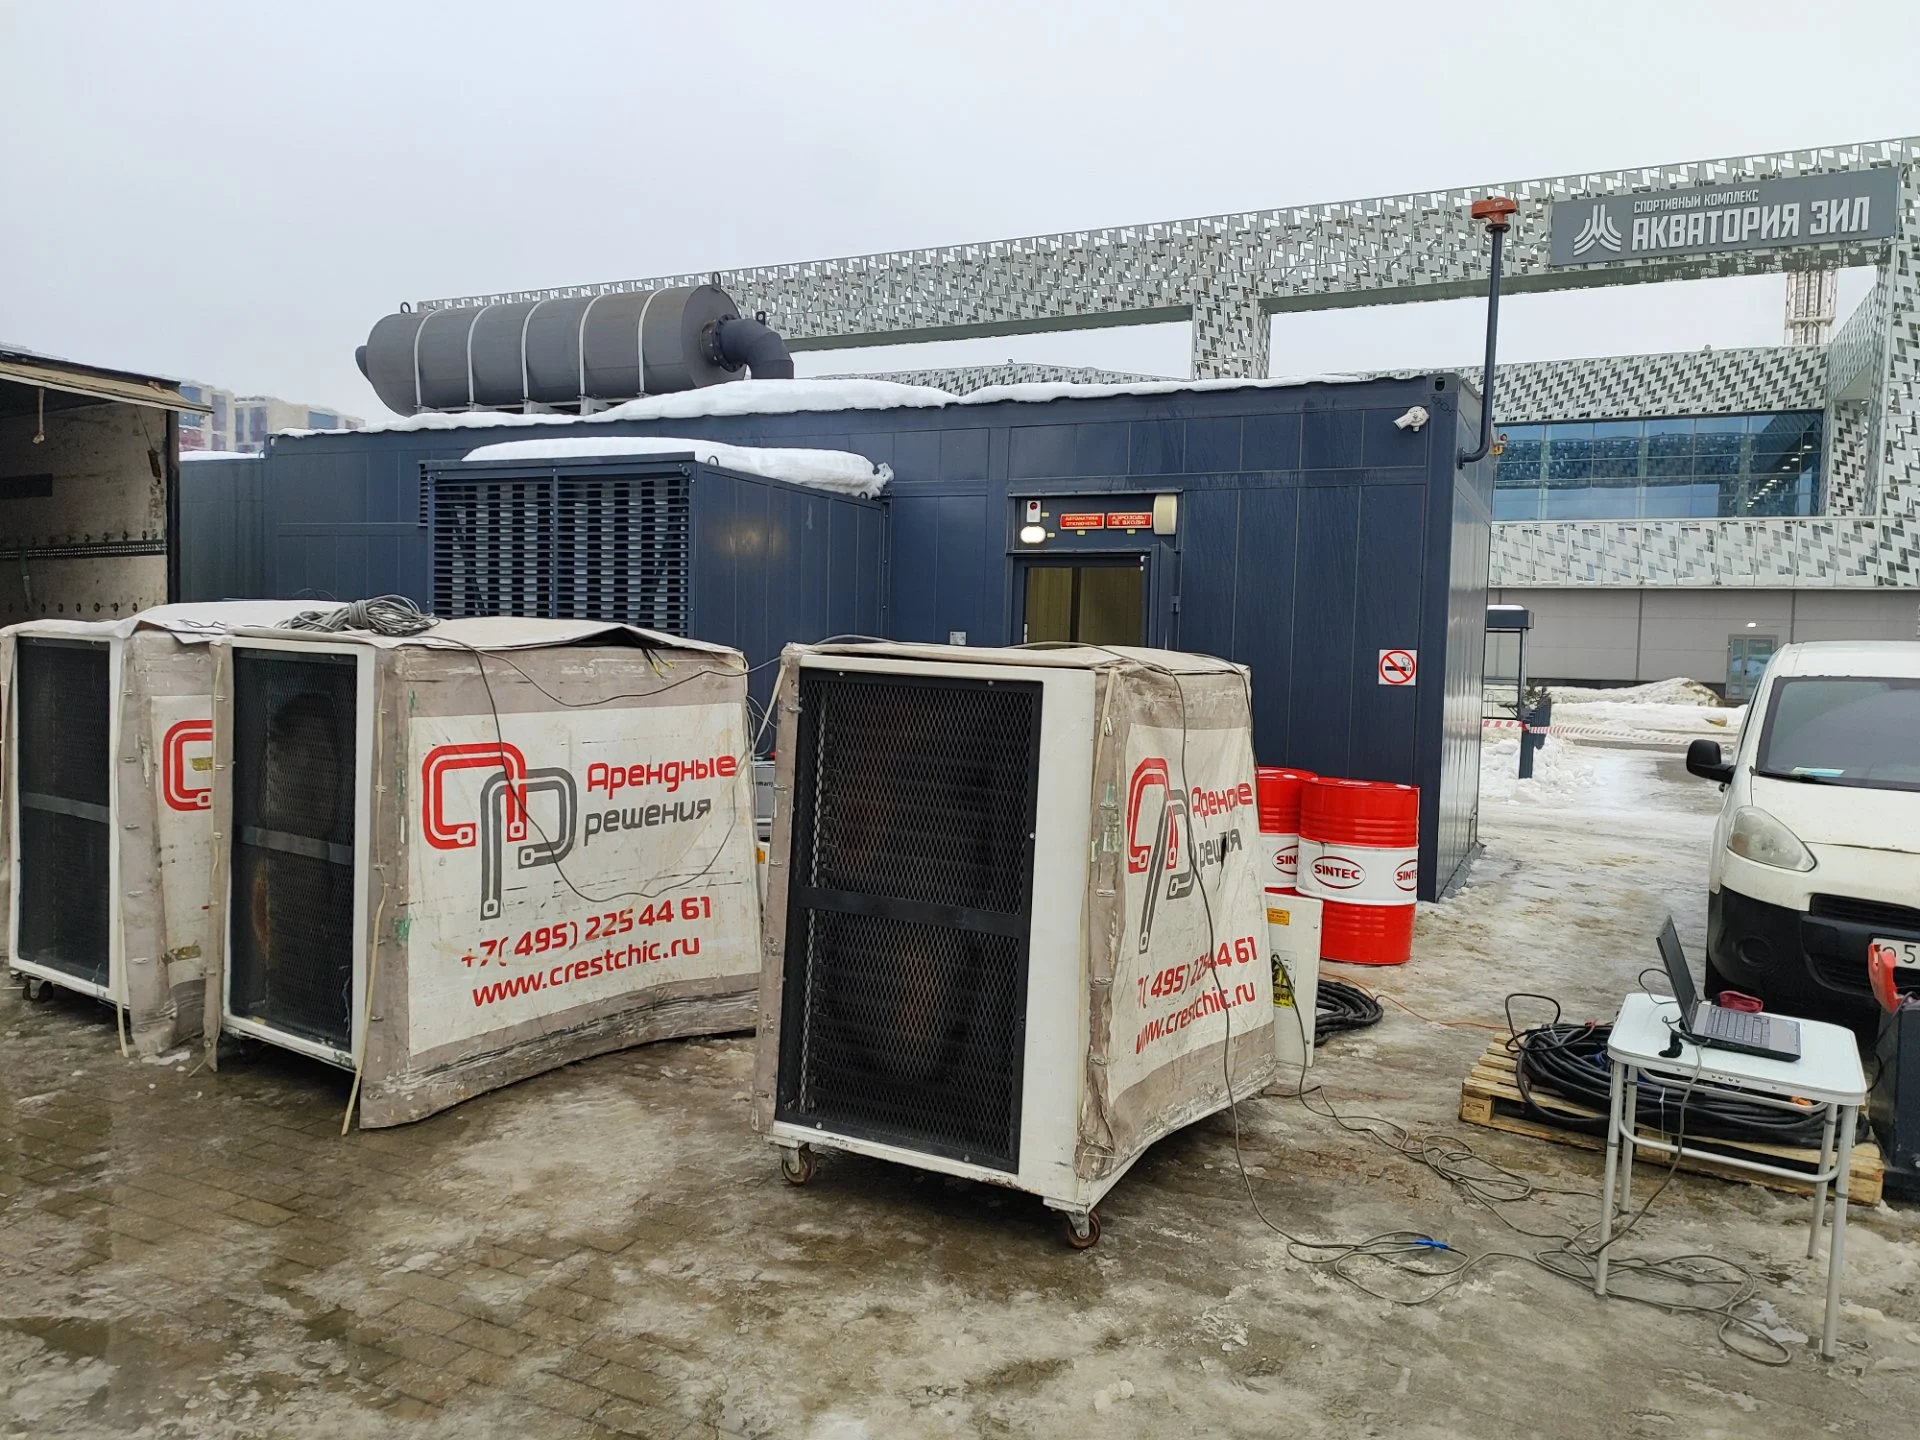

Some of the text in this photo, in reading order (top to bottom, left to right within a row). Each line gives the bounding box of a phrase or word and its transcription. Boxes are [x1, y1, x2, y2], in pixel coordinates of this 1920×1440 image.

[1633, 189, 1760, 214] СПОРТИВНЫЙ КОМПЛЕКС
[1631, 196, 1870, 251] АКВАТОРИЯ ЗИЛ
[586, 754, 737, 800] Арендные
[584, 798, 712, 847] решения
[1276, 855, 1298, 865] SIN
[1314, 864, 1361, 880] SINTEC
[1396, 869, 1417, 882] SINT
[638, 900, 675, 927] 44
[681, 896, 711, 920] 61
[1234, 936, 1257, 961] 61
[472, 937, 700, 1007] www.crestchic.ru
